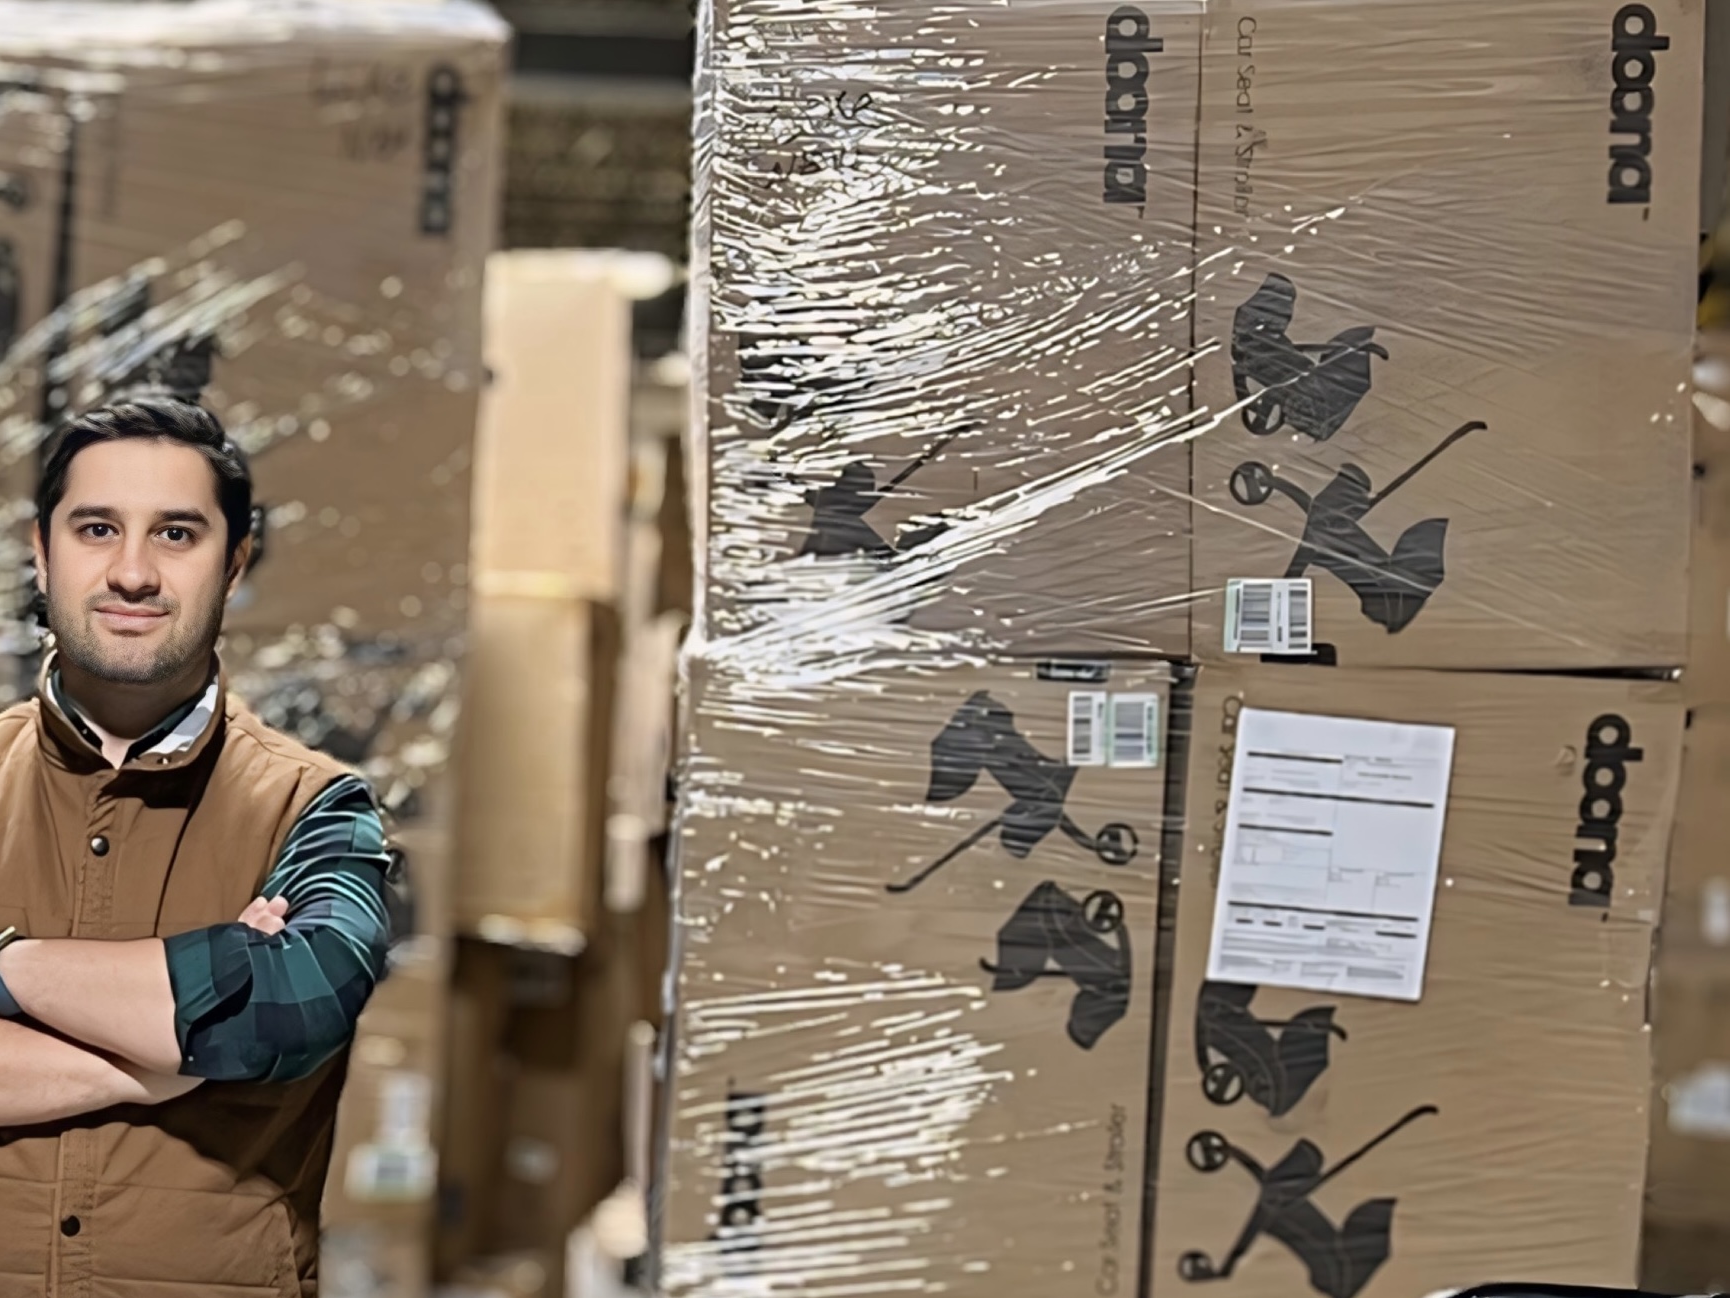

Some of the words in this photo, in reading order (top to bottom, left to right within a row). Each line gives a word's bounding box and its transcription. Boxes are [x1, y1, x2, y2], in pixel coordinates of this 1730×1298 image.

[1104, 5, 1163, 204] doona
[1607, 4, 1669, 204] doona
[1567, 713, 1643, 908] doona
